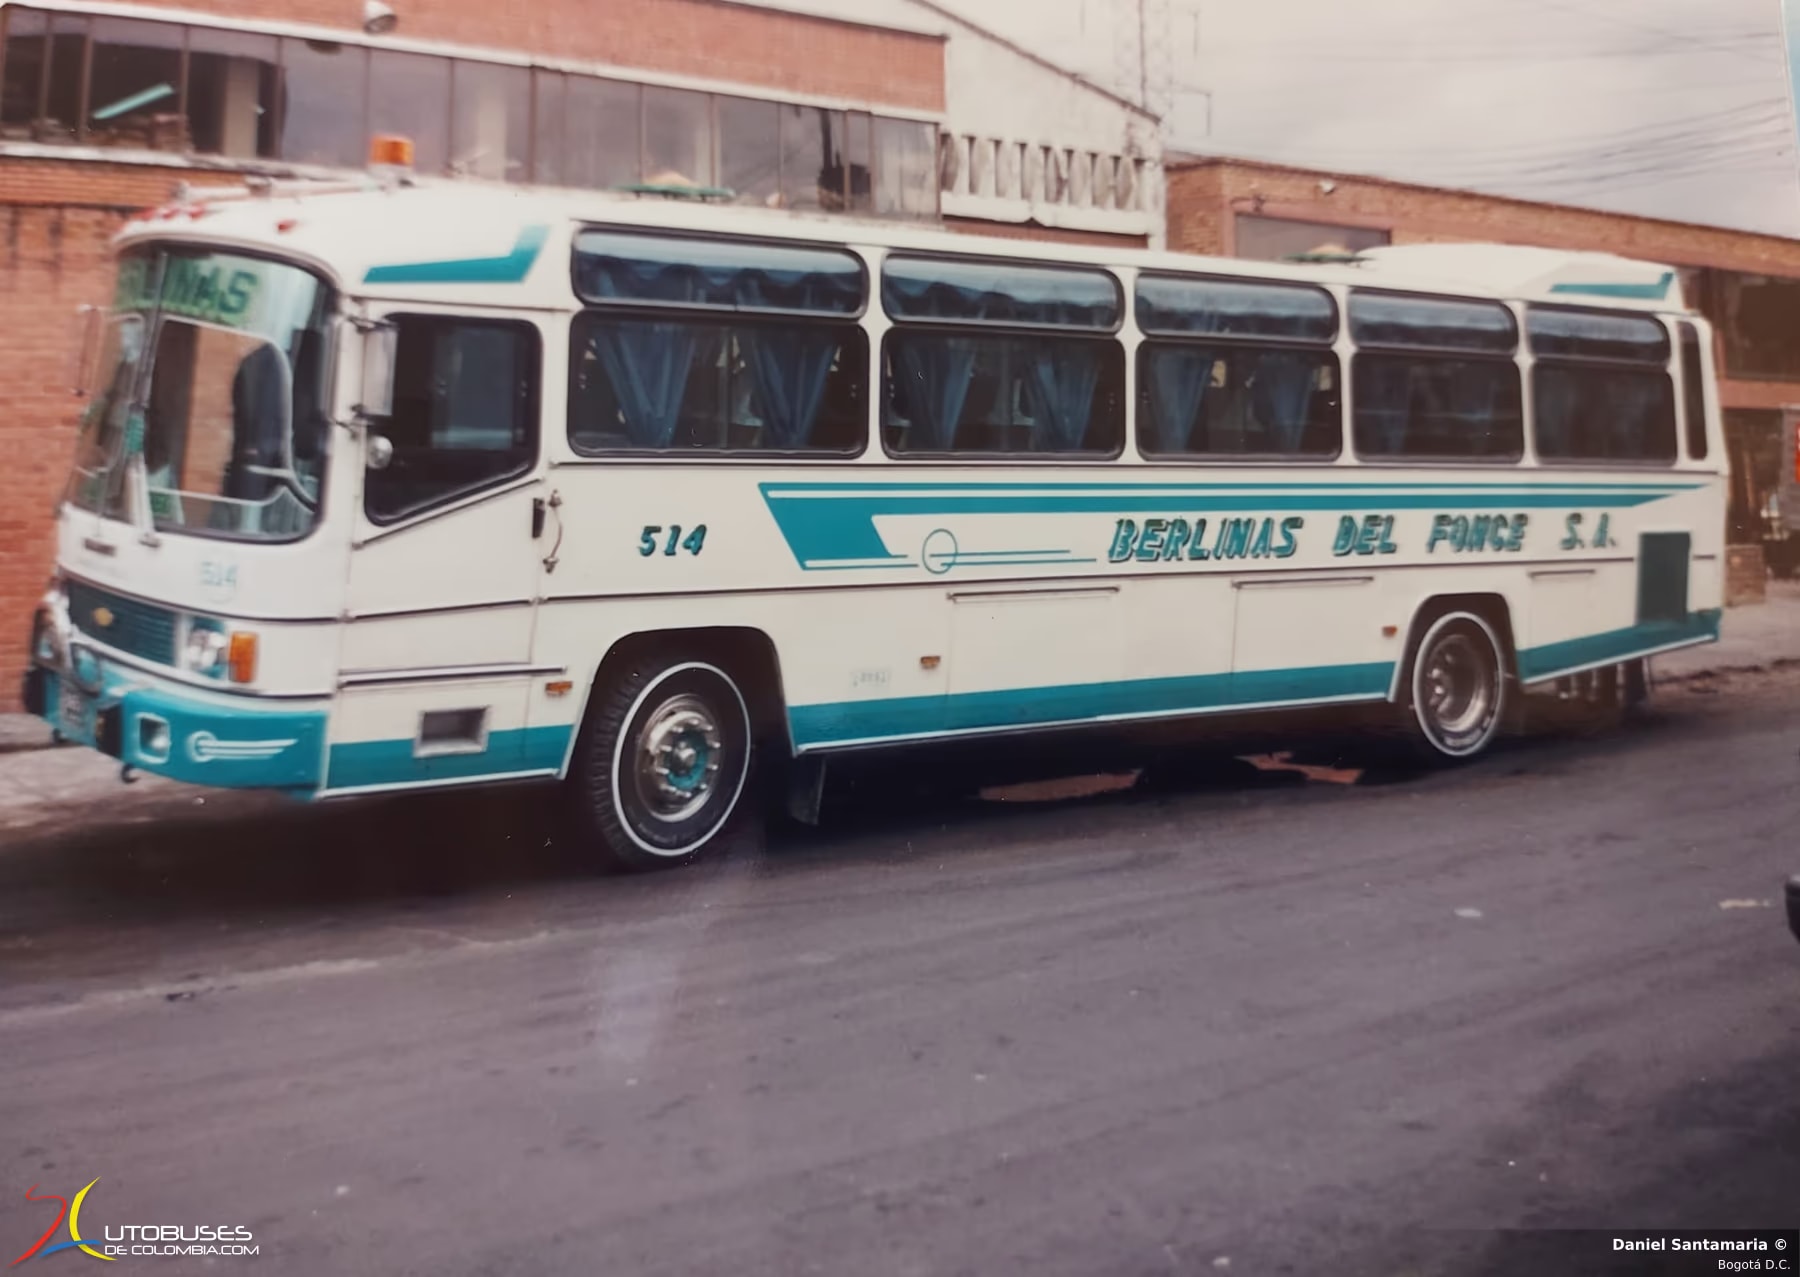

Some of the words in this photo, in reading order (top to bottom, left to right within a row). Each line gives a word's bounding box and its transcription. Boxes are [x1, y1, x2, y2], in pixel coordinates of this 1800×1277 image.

[637, 524, 708, 557] 514
[1108, 517, 1304, 563] BERLINAS
[1332, 514, 1398, 557] DEL
[201, 561, 238, 588] 514
